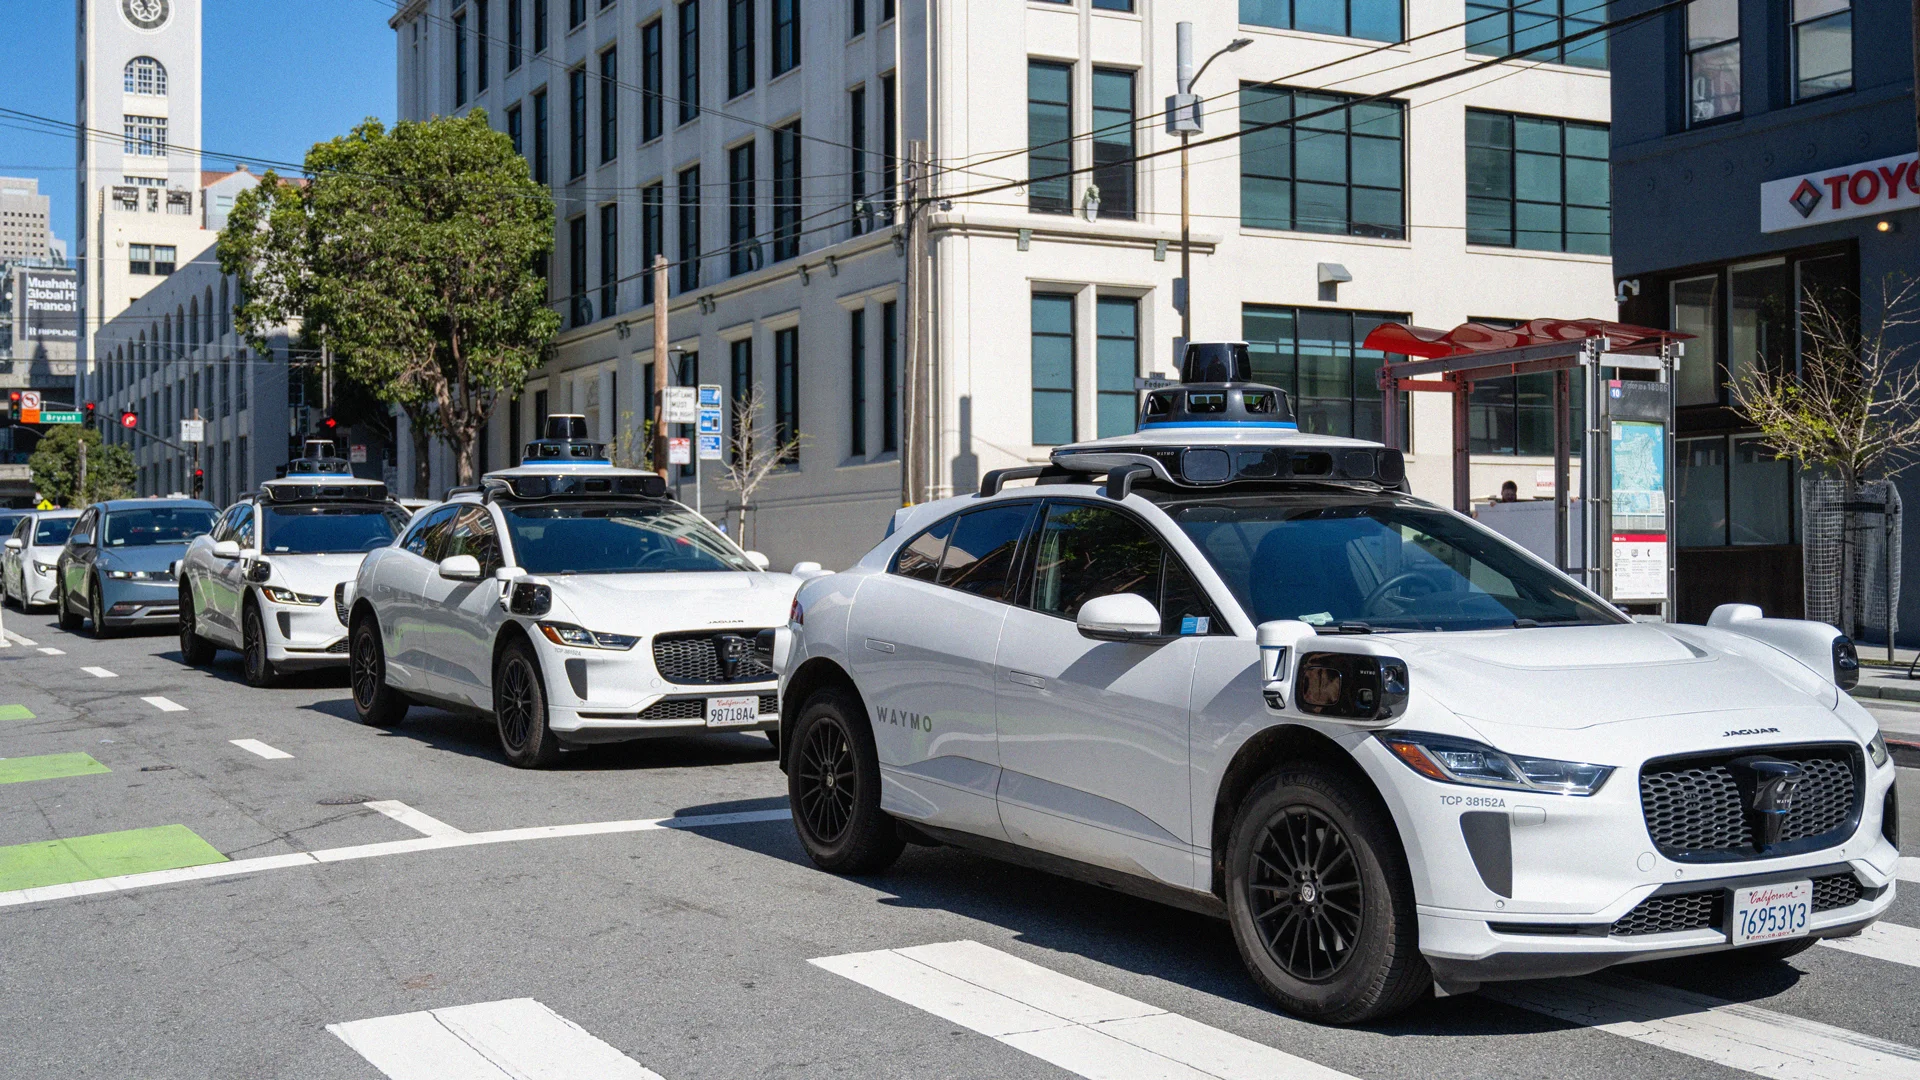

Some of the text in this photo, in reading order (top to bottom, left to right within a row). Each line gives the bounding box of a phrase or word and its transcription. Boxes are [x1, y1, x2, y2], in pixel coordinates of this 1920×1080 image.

[27, 288, 64, 300] Global
[27, 299, 71, 312] Finance
[1611, 388, 1620, 398] 10
[46, 412, 76, 422] Bryant
[710, 707, 755, 722] 98718A4
[876, 706, 932, 733] WAYMO
[1722, 727, 1781, 738] JAGUAR
[1440, 795, 1506, 808] TCP 38152A
[1750, 889, 1798, 906] California
[1739, 902, 1807, 936] 76953Y3
[1750, 930, 1791, 940] dmv.ca.gov
